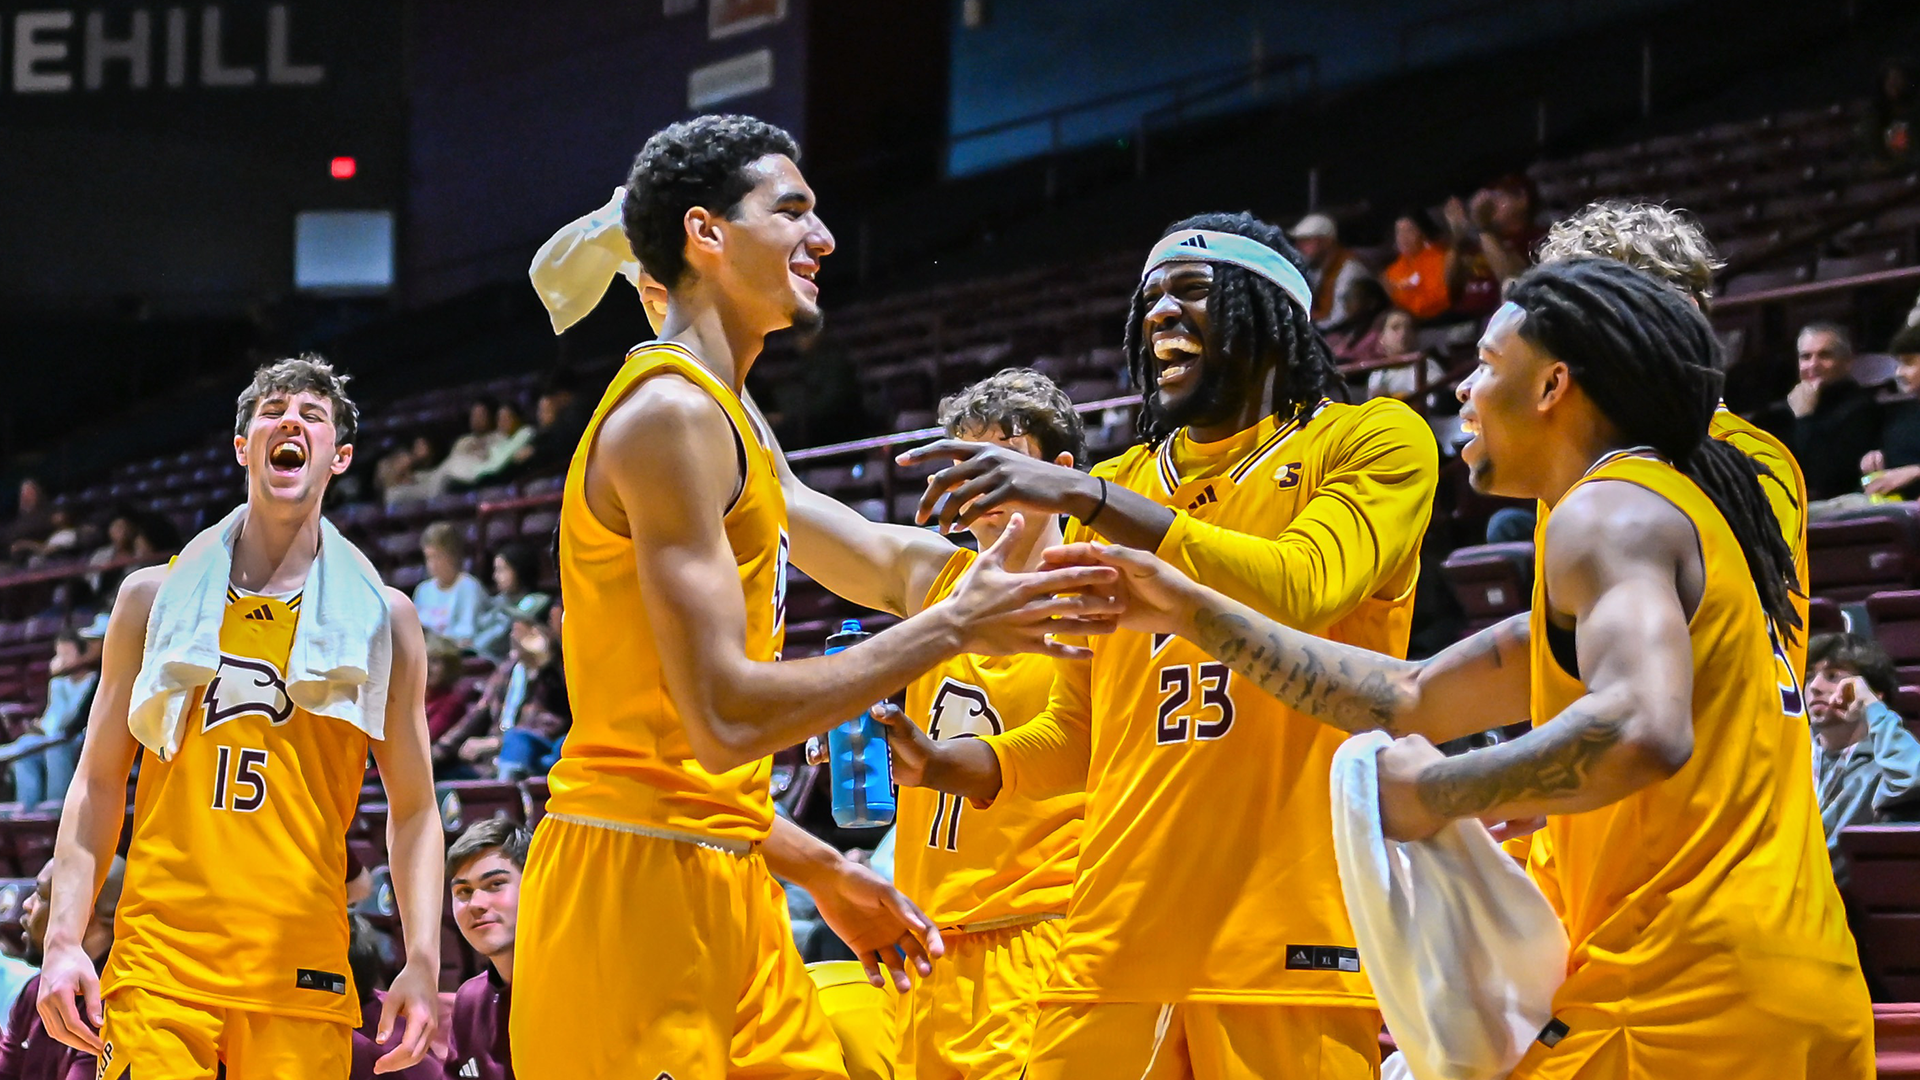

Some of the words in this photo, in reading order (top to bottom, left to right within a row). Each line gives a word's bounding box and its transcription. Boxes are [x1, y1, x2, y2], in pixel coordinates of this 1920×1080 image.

[1156, 660, 1236, 746] 23
[210, 745, 269, 813] 15
[926, 789, 965, 853] 11
[1321, 956, 1332, 965] XL
